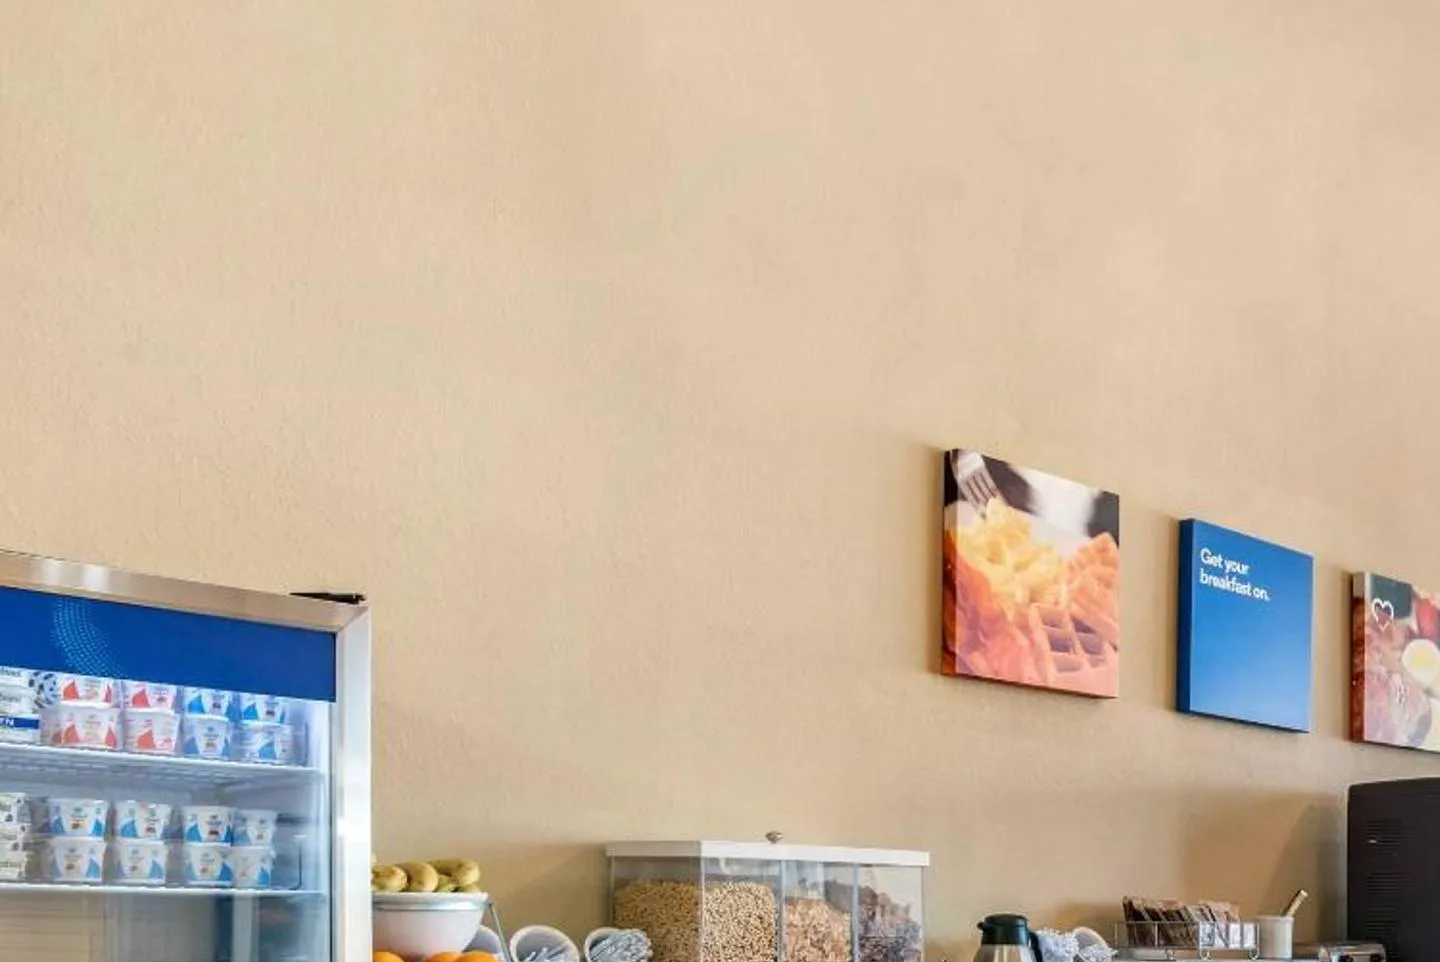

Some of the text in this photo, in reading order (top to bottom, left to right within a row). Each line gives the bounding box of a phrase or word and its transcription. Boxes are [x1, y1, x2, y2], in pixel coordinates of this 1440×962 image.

[1200, 547, 1250, 574] Get your
[1199, 567, 1271, 602] breakfast on.
